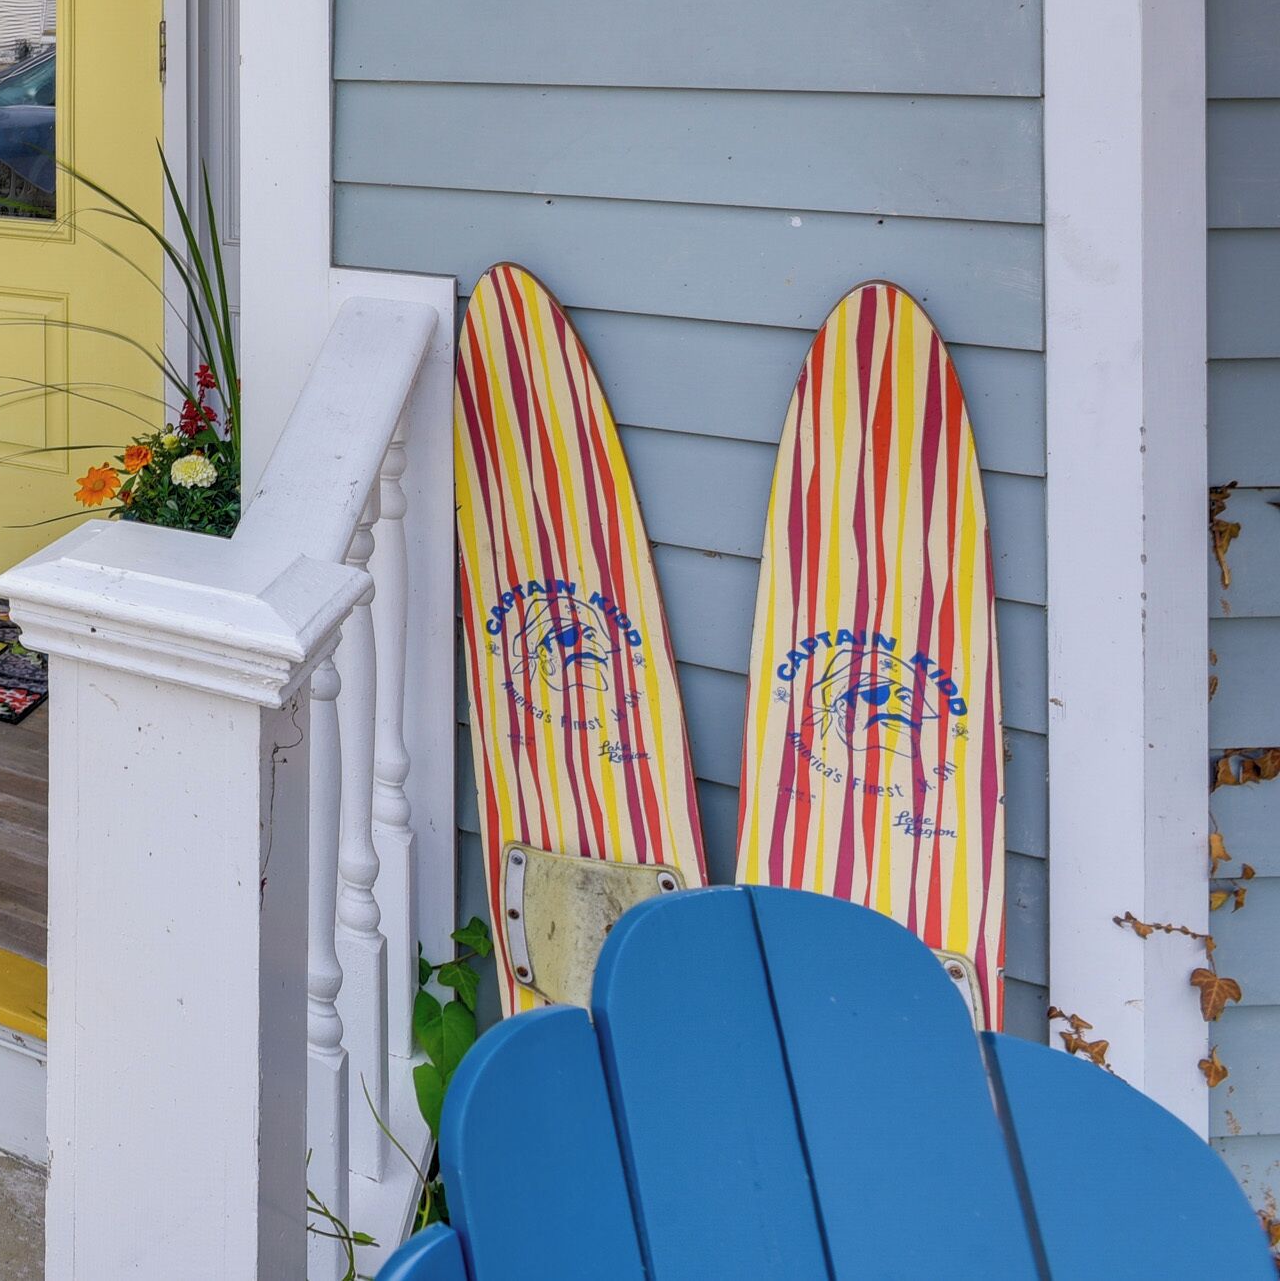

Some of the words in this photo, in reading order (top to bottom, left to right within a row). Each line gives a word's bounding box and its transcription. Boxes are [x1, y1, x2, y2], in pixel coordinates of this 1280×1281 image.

[486, 579, 576, 635] CAPTAIN
[589, 591, 642, 647] KIDD
[777, 629, 897, 681] CAPTAIN
[909, 651, 967, 716] KIDD
[788, 731, 843, 783] America's
[852, 777, 904, 797] Finest
[892, 810, 934, 826] Lake
[903, 824, 957, 838] Region
